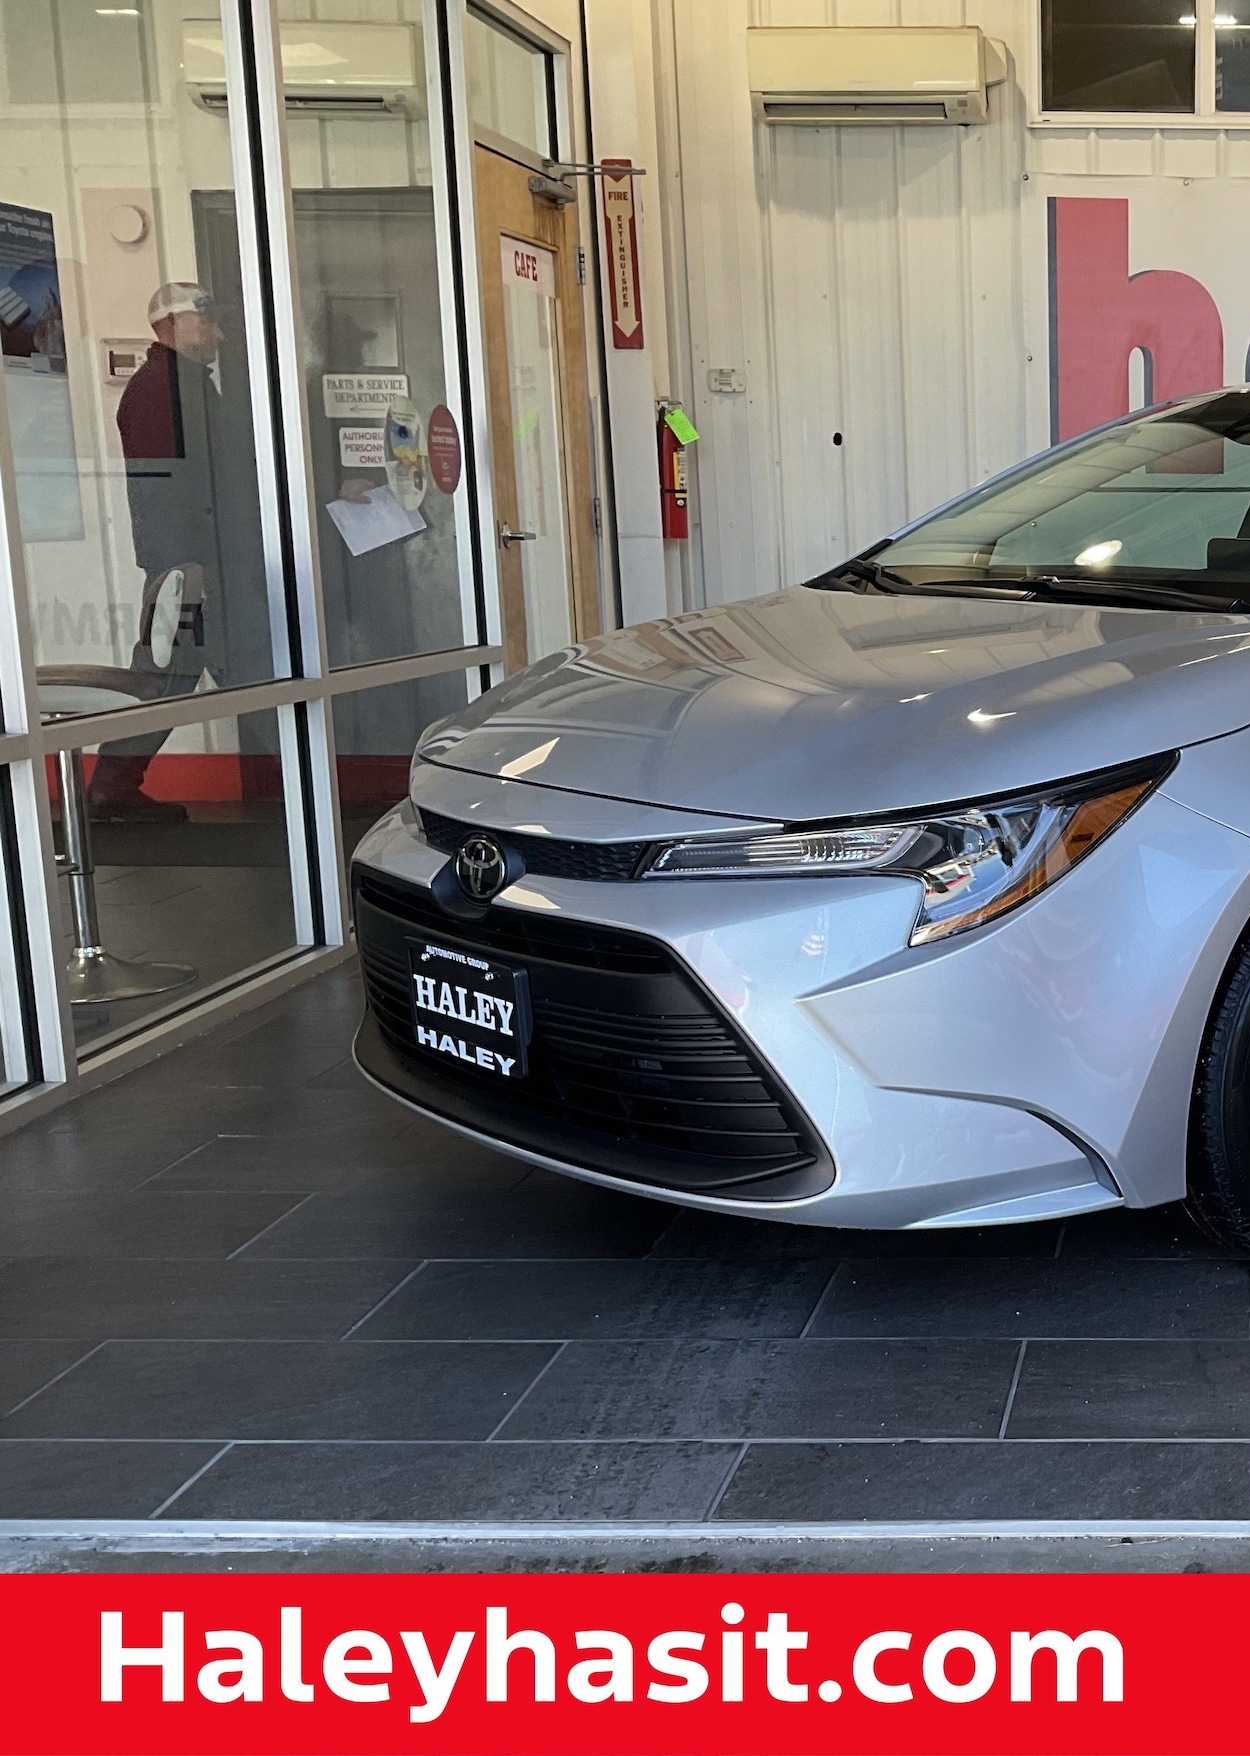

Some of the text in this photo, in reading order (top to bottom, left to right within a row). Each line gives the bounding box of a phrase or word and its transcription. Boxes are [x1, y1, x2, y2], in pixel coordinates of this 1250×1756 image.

[608, 191, 628, 201] FIRE
[514, 250, 538, 282] CAFE
[616, 214, 629, 309] EXTINGUISHER
[326, 379, 404, 390] PARTS & SERVICE
[359, 456, 383, 464] ONLY
[426, 945, 489, 971] AUTOMOTIVE GROUP
[413, 973, 514, 1037] HALEY
[417, 1025, 516, 1077] HALEY
